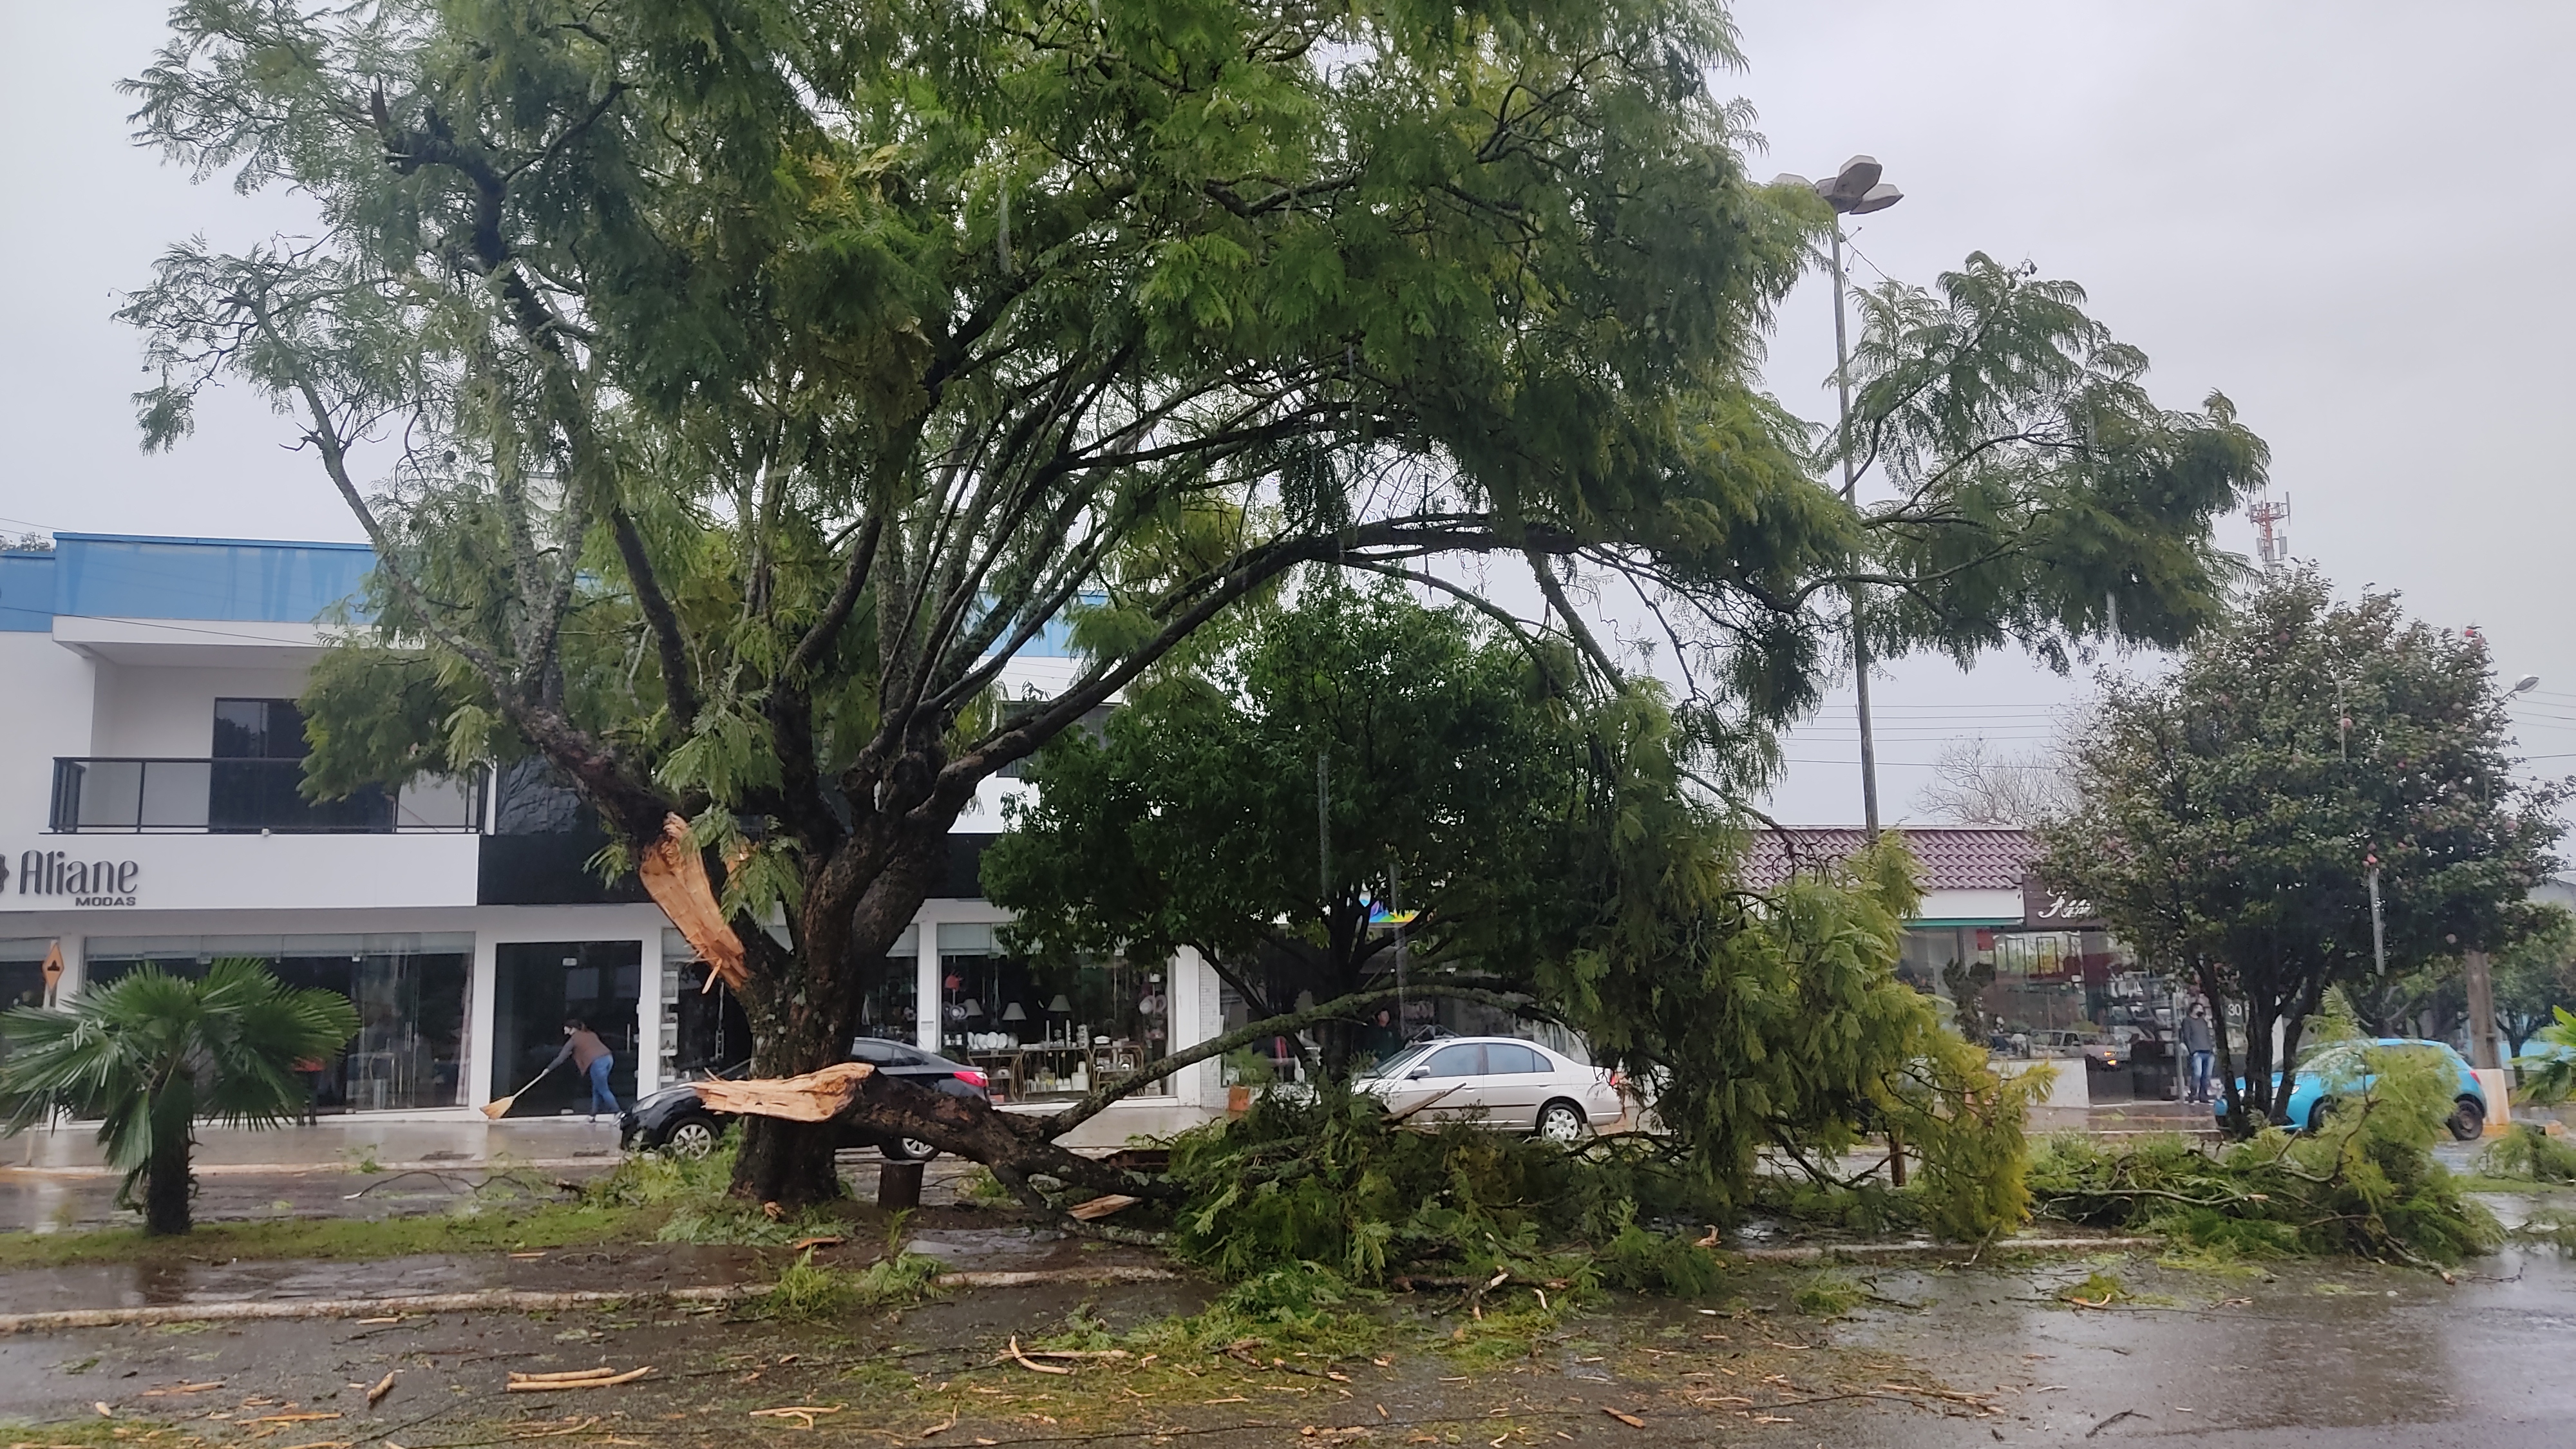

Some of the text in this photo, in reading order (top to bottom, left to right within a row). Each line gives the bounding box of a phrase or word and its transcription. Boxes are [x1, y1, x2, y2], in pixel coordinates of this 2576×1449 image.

[19, 849, 139, 895] Aliane
[75, 896, 137, 906] MODAS
[2228, 1003, 2242, 1016] 30
